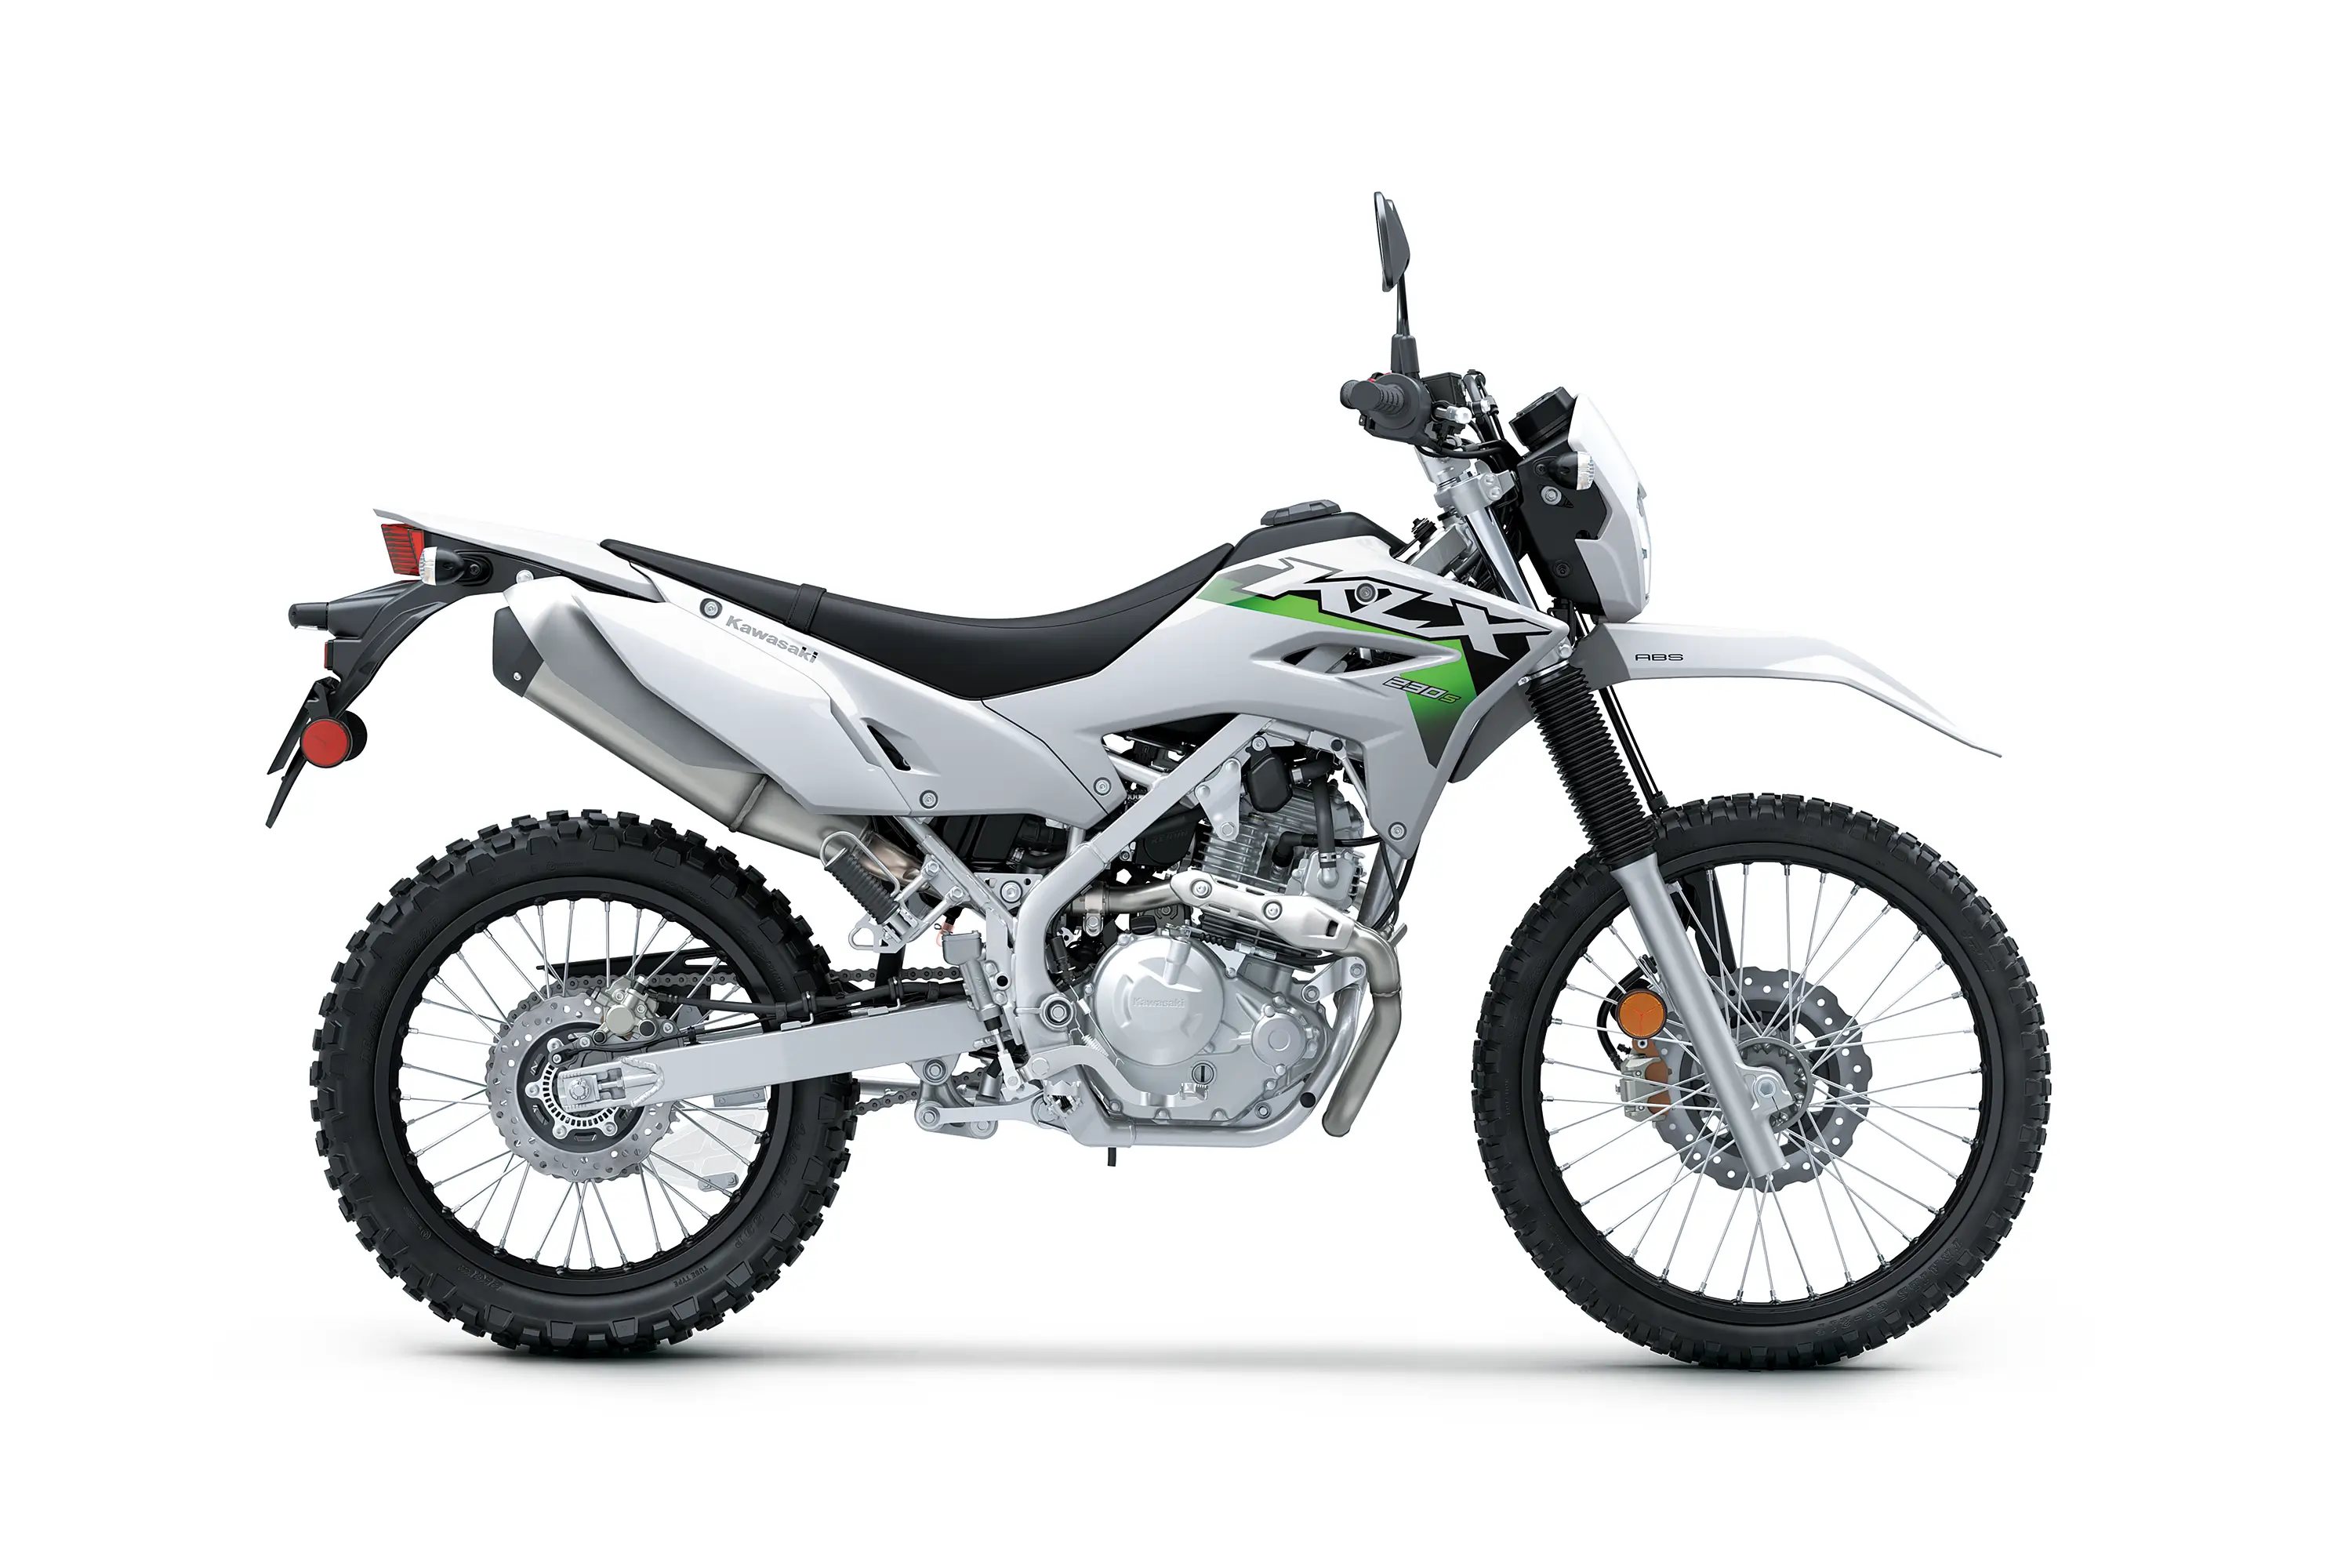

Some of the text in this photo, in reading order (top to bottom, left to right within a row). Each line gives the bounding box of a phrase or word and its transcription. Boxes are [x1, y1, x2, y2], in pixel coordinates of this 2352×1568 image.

[1231, 557, 1552, 660] KLX
[726, 615, 818, 663] Kawasaki
[1133, 996, 1185, 1009] Kawasaki
[673, 1265, 709, 1287] TUBE TYPE
